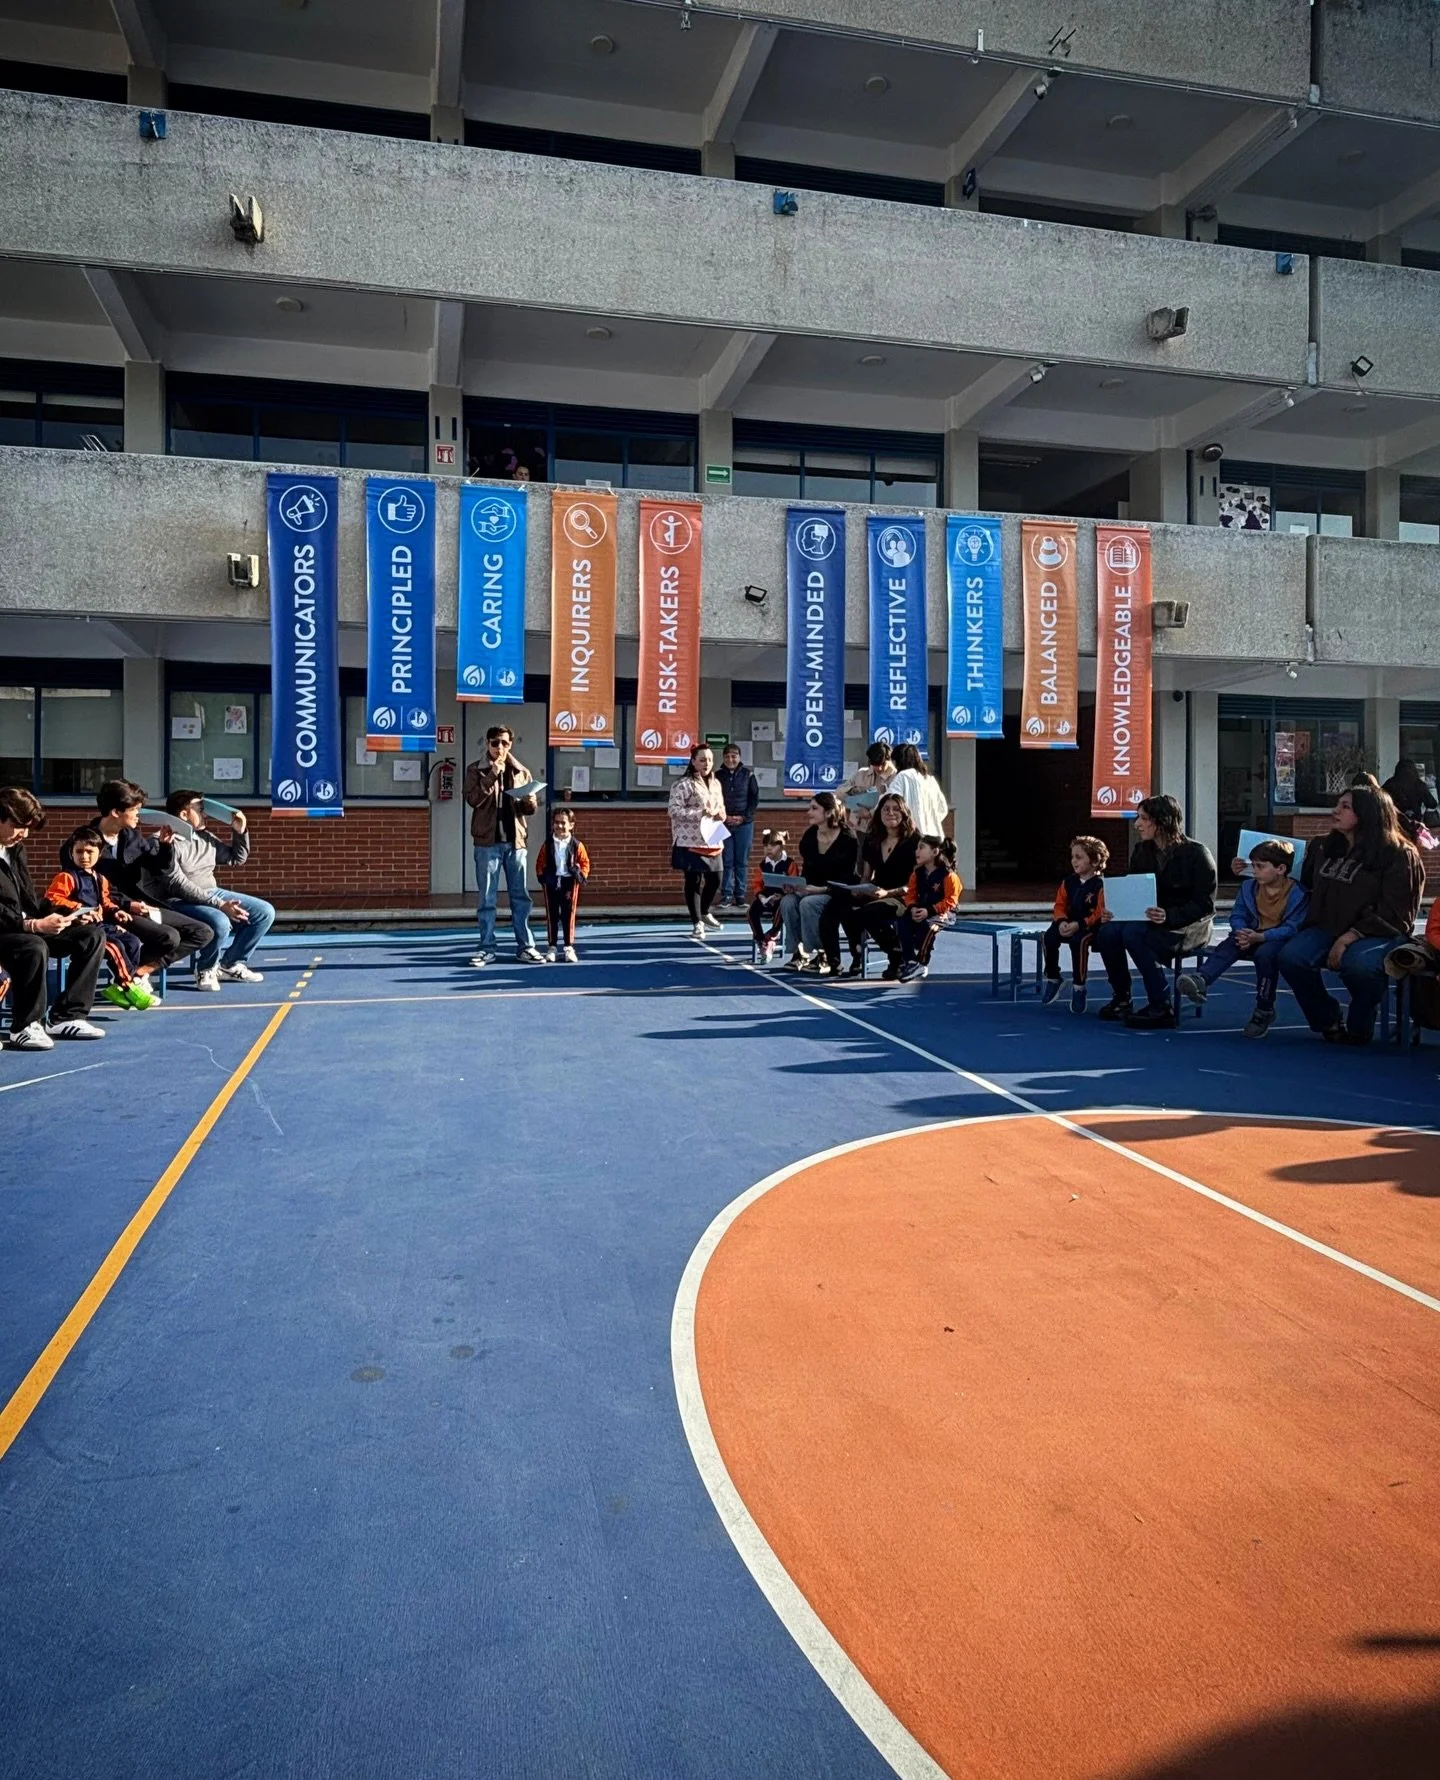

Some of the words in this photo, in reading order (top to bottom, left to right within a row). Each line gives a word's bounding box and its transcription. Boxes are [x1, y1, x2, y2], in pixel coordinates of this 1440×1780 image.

[294, 544, 318, 768] COMMUNICATORS
[391, 545, 412, 693] PRINCIPLED
[481, 553, 503, 649] CARING
[571, 558, 594, 692] INQUIRERS
[658, 565, 680, 714] RISK-TAKERS
[805, 571, 825, 748] OPEN-MINDED
[889, 578, 907, 710] REFLECTIVE
[967, 576, 984, 691] THINKERS
[1040, 581, 1058, 705] BALANCED
[1112, 584, 1132, 776] KNOWLEDGEABLE
